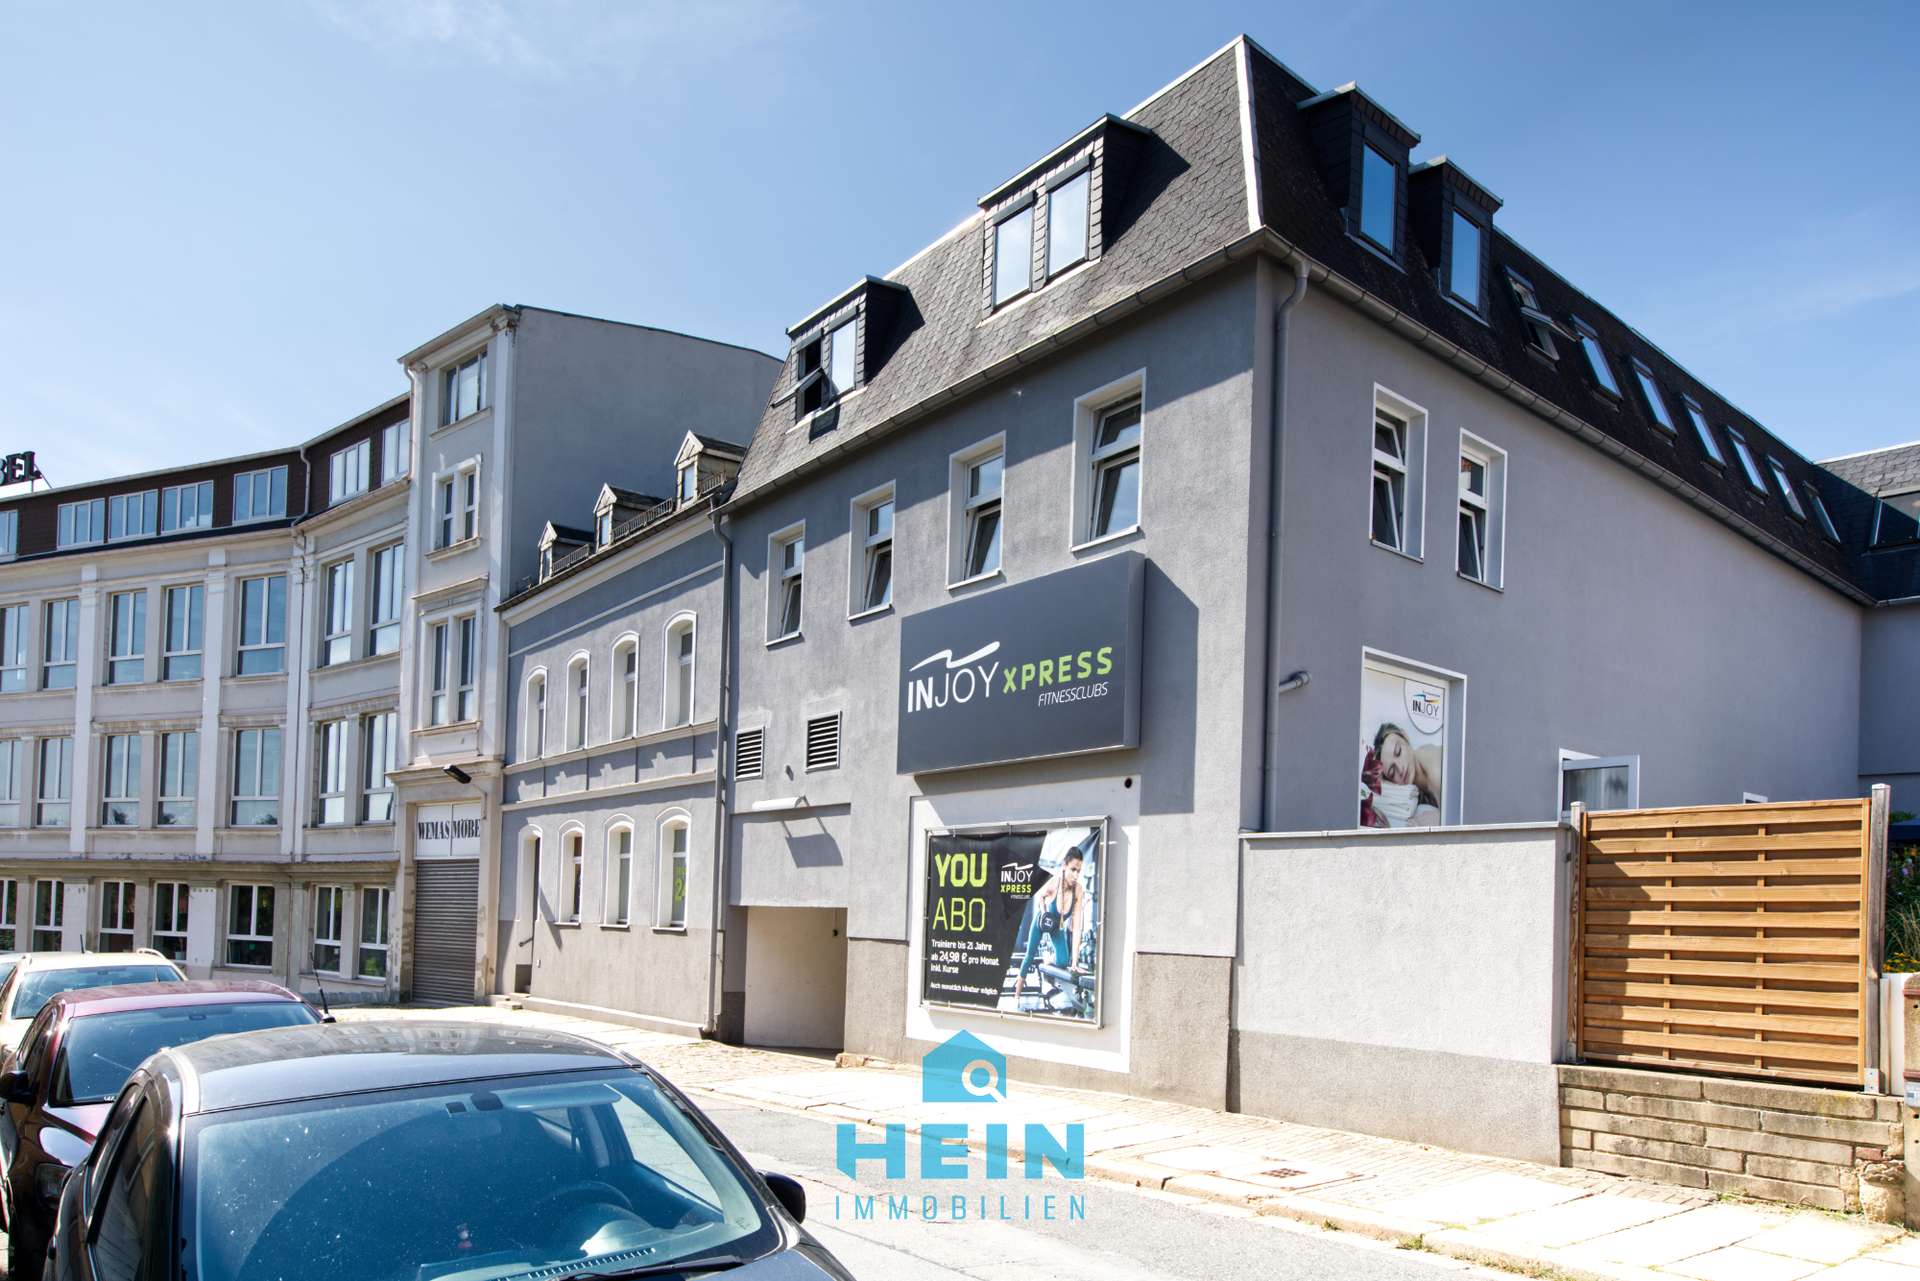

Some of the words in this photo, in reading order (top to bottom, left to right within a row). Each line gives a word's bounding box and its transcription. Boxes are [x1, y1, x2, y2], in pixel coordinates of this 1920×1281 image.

[907, 661, 1000, 713] INJOY
[1002, 646, 1113, 694] XPRESS
[1038, 681, 1109, 707] FITNESSCLUBS
[1412, 700, 1439, 717] INJOY
[418, 821, 450, 840] WEMAS
[935, 853, 988, 888] YOU
[1000, 870, 1034, 883] INJOY
[1000, 884, 1032, 893] XPRESS
[932, 897, 986, 932] ABO
[931, 939, 956, 949] Trainiere
[957, 940, 966, 949] bis
[975, 941, 993, 951] Jahre
[931, 953, 939, 961] ab
[961, 952, 968, 963] €
[968, 957, 979, 965] pro
[942, 964, 959, 974] Kurse
